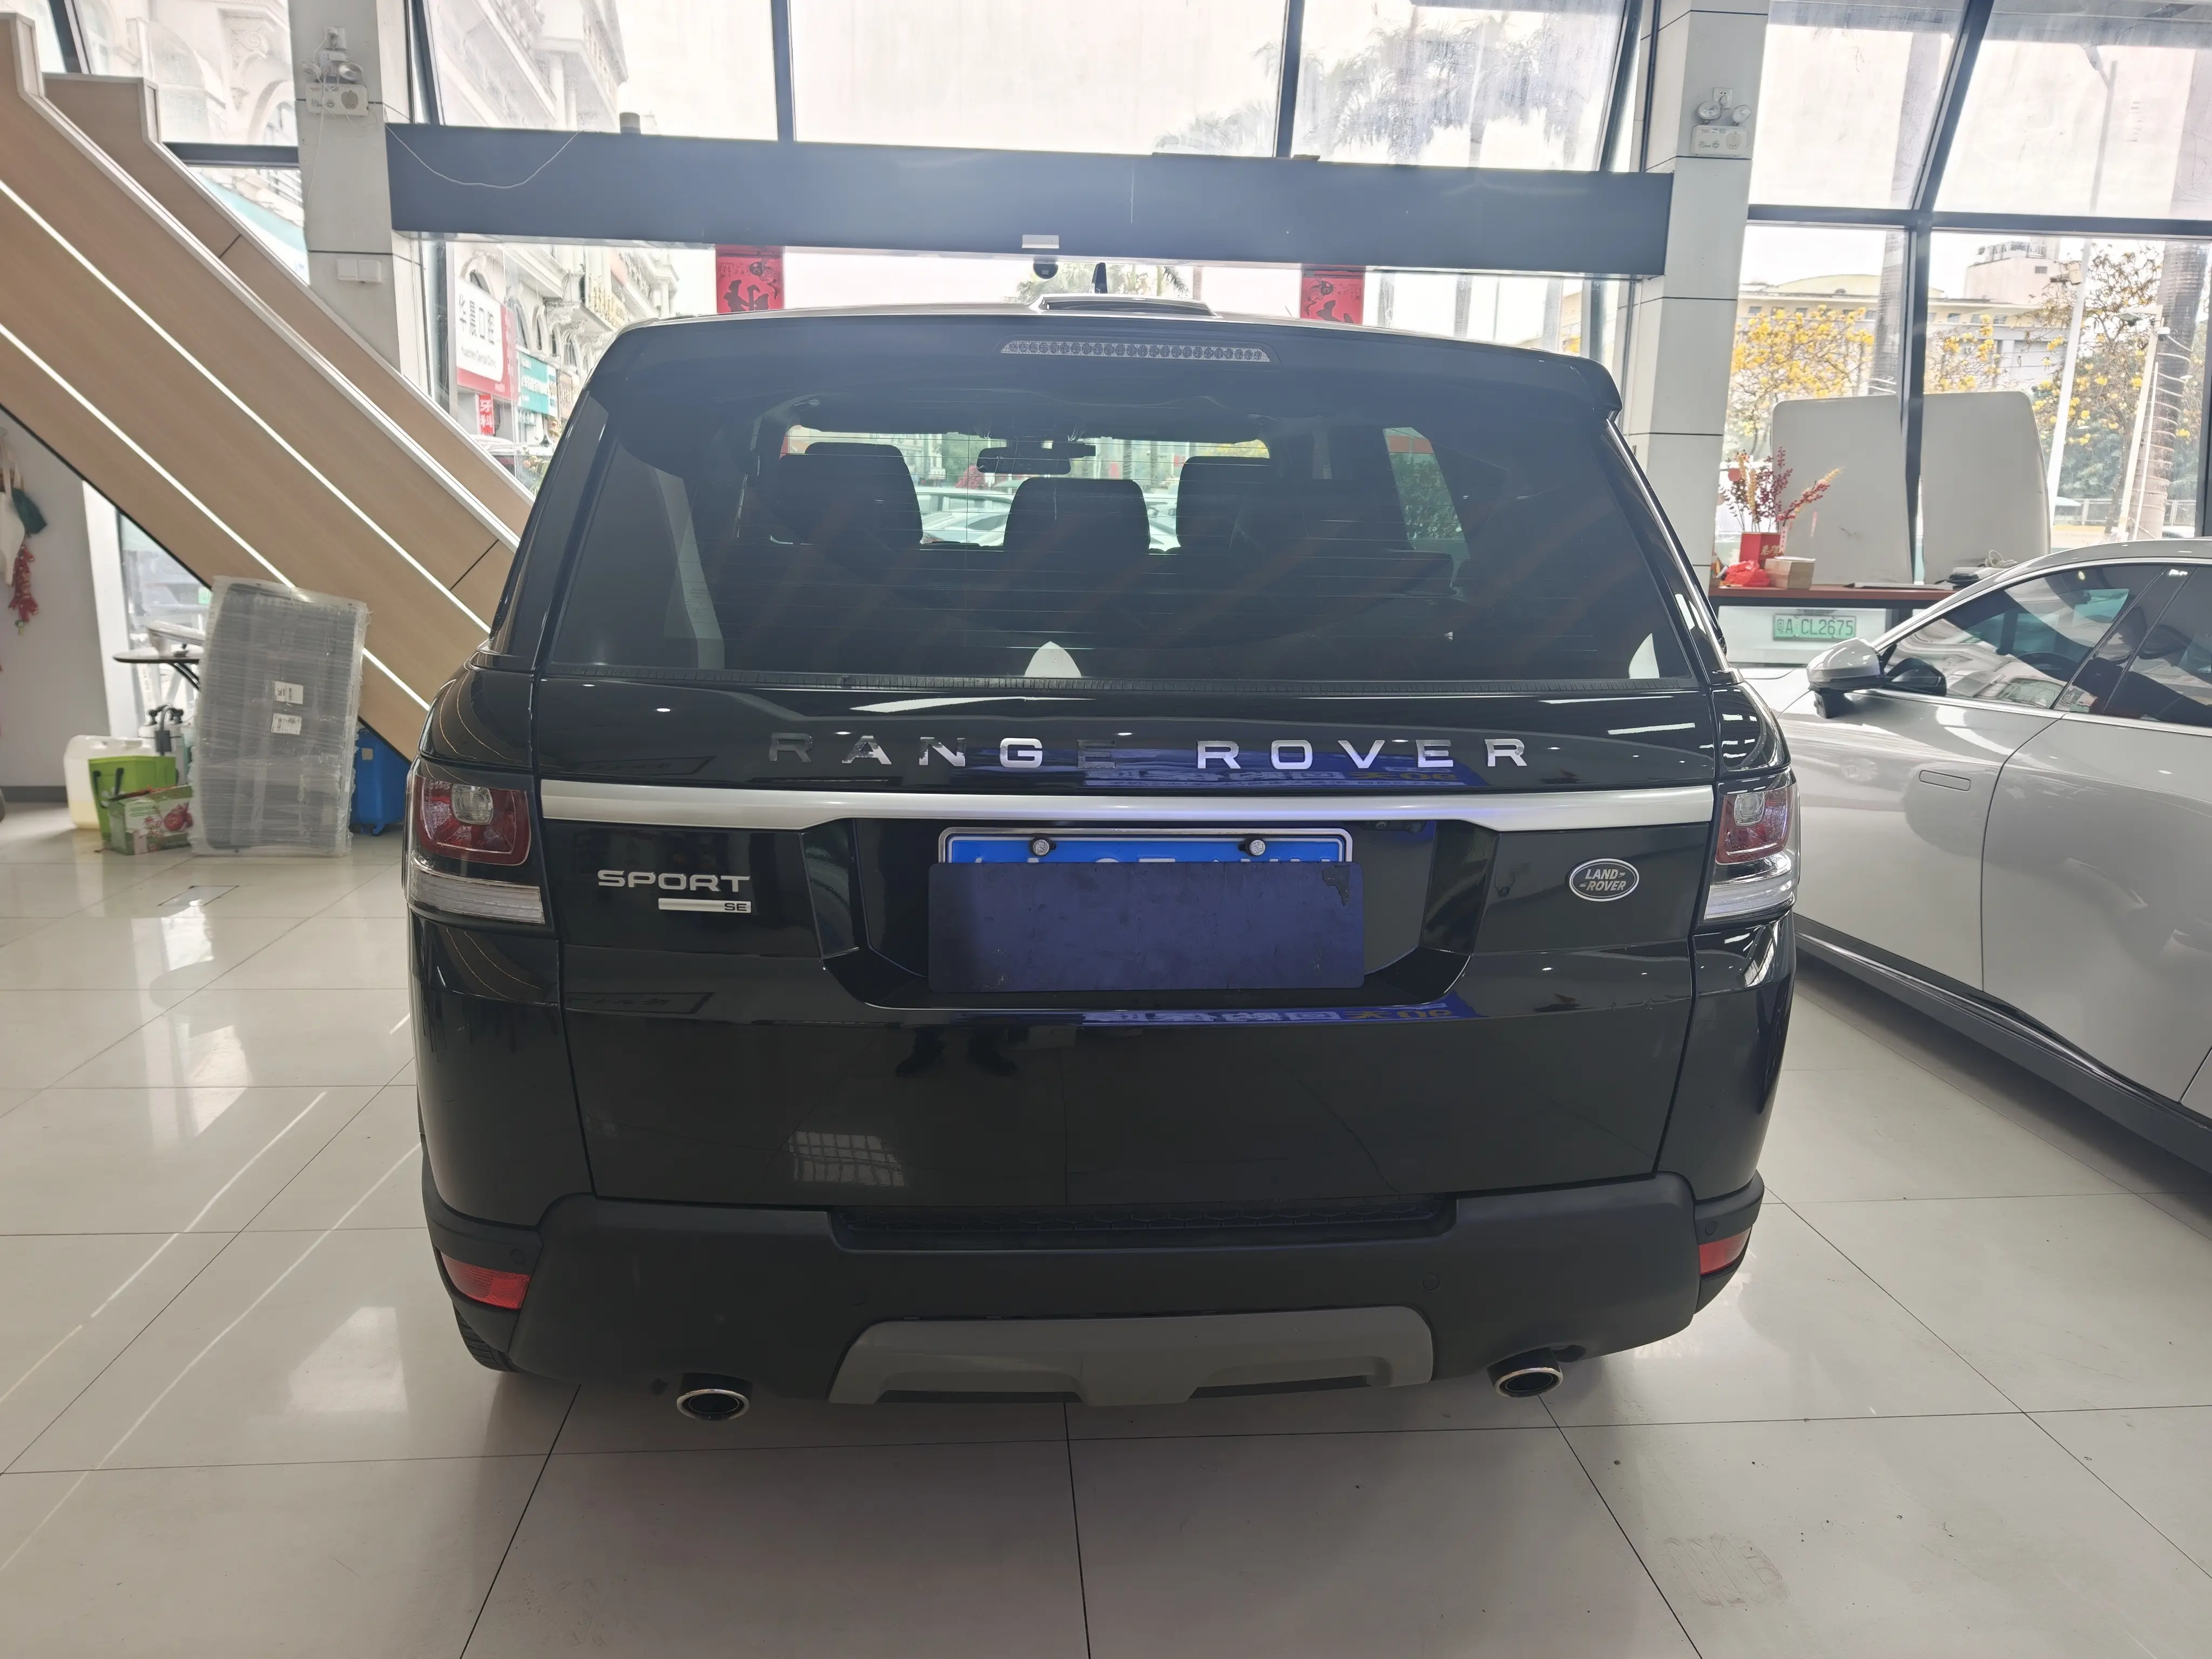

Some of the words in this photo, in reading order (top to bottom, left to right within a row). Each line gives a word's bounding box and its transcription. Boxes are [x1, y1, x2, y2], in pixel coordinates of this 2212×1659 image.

[769, 732, 1117, 768] RANGE
[1196, 738, 1528, 770] ROVER
[1584, 868, 1618, 880] LAND
[597, 869, 751, 892] SPORT
[1586, 880, 1627, 891] ROVER
[724, 902, 747, 912] SE
